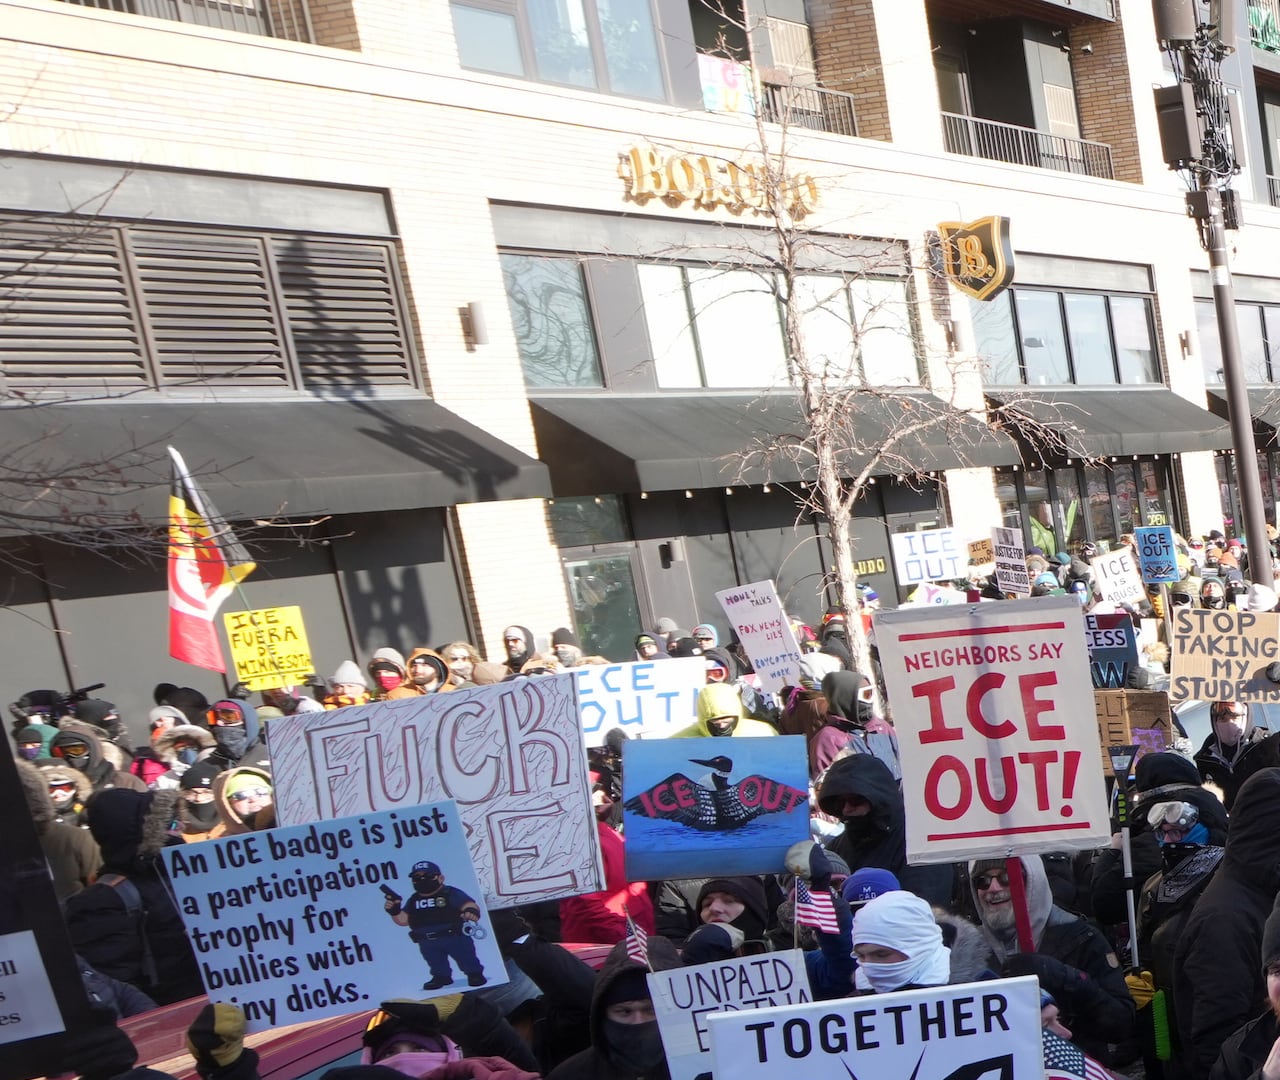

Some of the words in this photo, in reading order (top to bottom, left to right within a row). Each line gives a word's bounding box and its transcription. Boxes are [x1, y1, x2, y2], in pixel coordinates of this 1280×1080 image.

[1142, 544, 1171, 557] OUT
[1143, 533, 1167, 546] ICE
[231, 626, 299, 648] FUERA
[1177, 609, 1256, 635] STOP
[905, 646, 1021, 672] NEIGHBORS
[1027, 642, 1065, 662] SAY
[1175, 635, 1279, 658] TAKING
[1173, 676, 1280, 701] STUDENTS
[1211, 658, 1250, 680] MY
[912, 671, 1066, 744] ICE
[305, 681, 571, 816] FUCK
[640, 778, 696, 816] ICE
[738, 776, 809, 814] OUT
[925, 750, 1082, 821] OUT!
[172, 850, 208, 878] An
[215, 837, 262, 869] ICE
[267, 825, 352, 860] badge
[359, 819, 384, 844] is
[390, 808, 447, 848] just
[183, 896, 200, 915] a
[208, 860, 399, 919] participation
[415, 899, 436, 910] ICE
[192, 908, 293, 952] trophy
[302, 905, 348, 933] for
[203, 954, 299, 994] bullies
[307, 935, 372, 970] with
[669, 959, 793, 1009] UNPAID
[744, 994, 1010, 1062] TOGETHER
